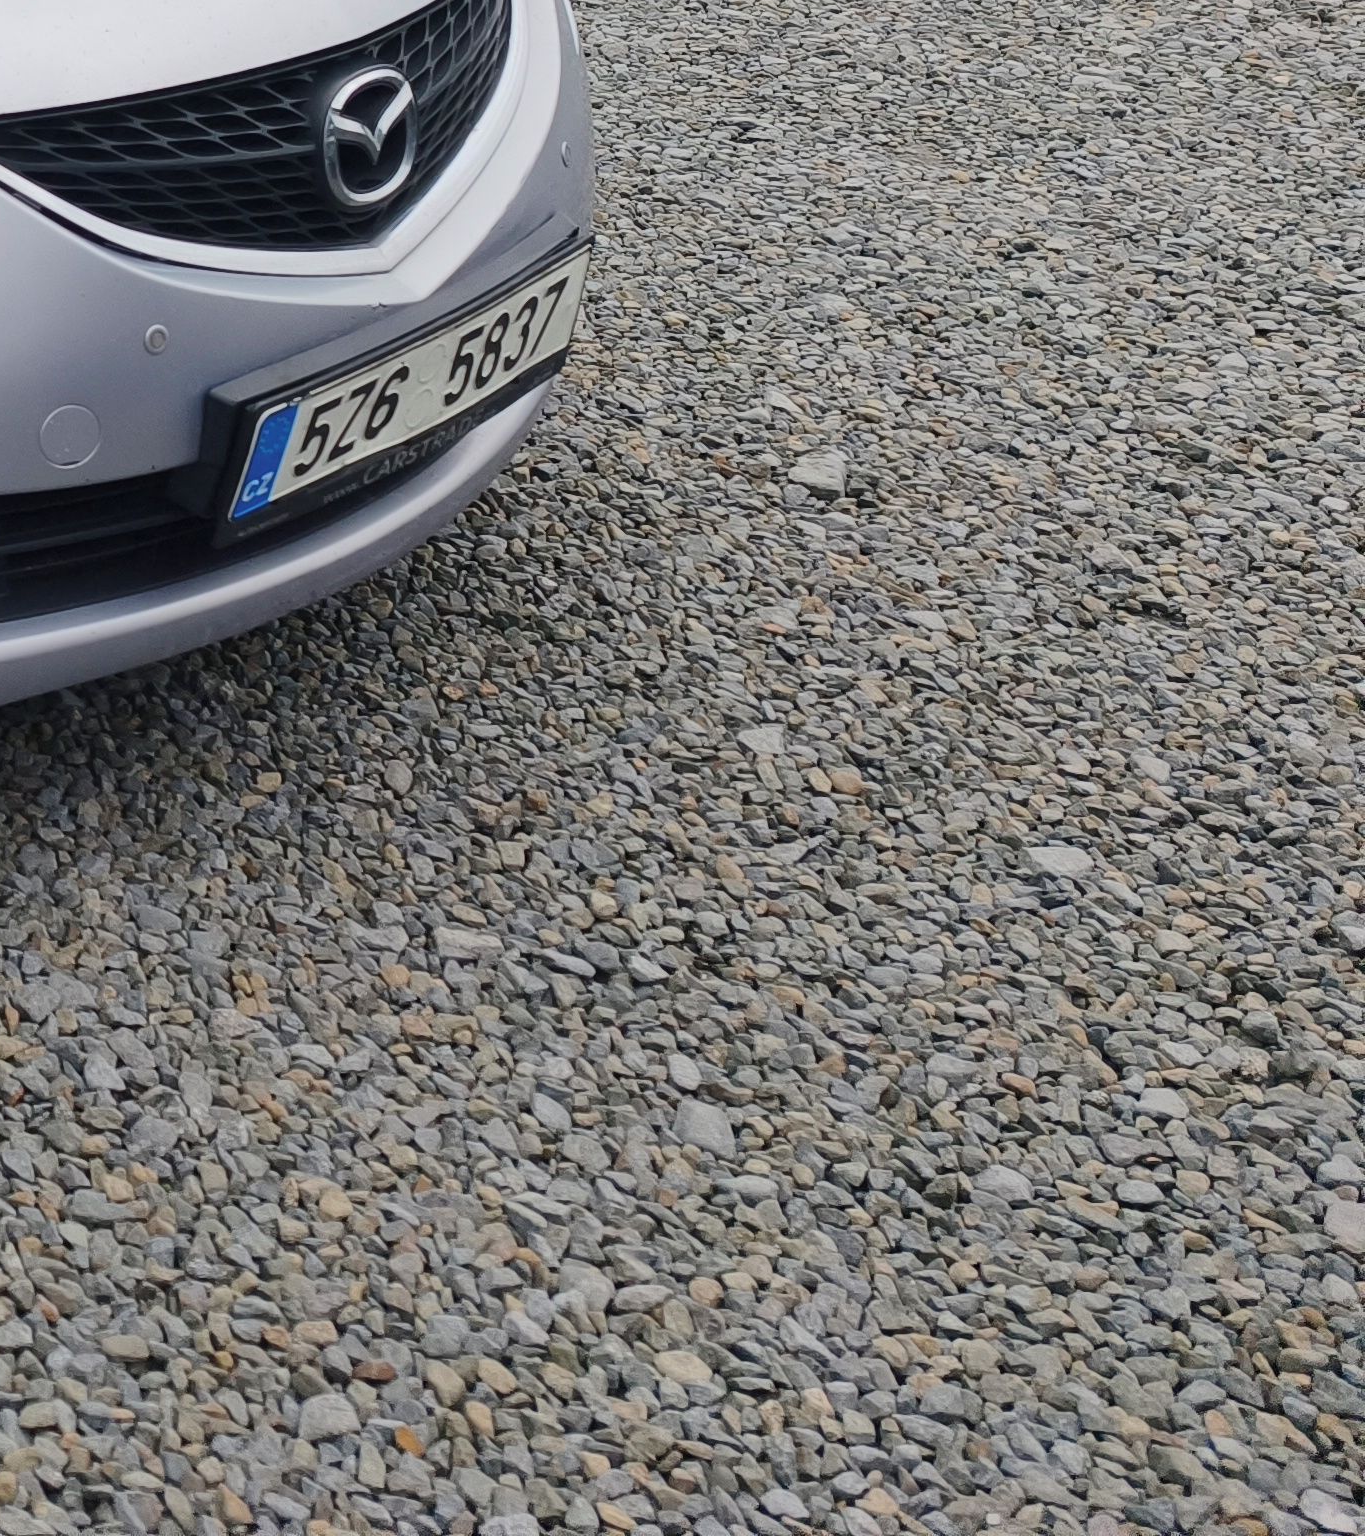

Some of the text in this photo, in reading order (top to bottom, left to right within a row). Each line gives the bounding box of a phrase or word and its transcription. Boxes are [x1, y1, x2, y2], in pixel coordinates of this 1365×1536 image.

[293, 276, 569, 477] 5Z6 5837
[242, 472, 274, 502] CZ
